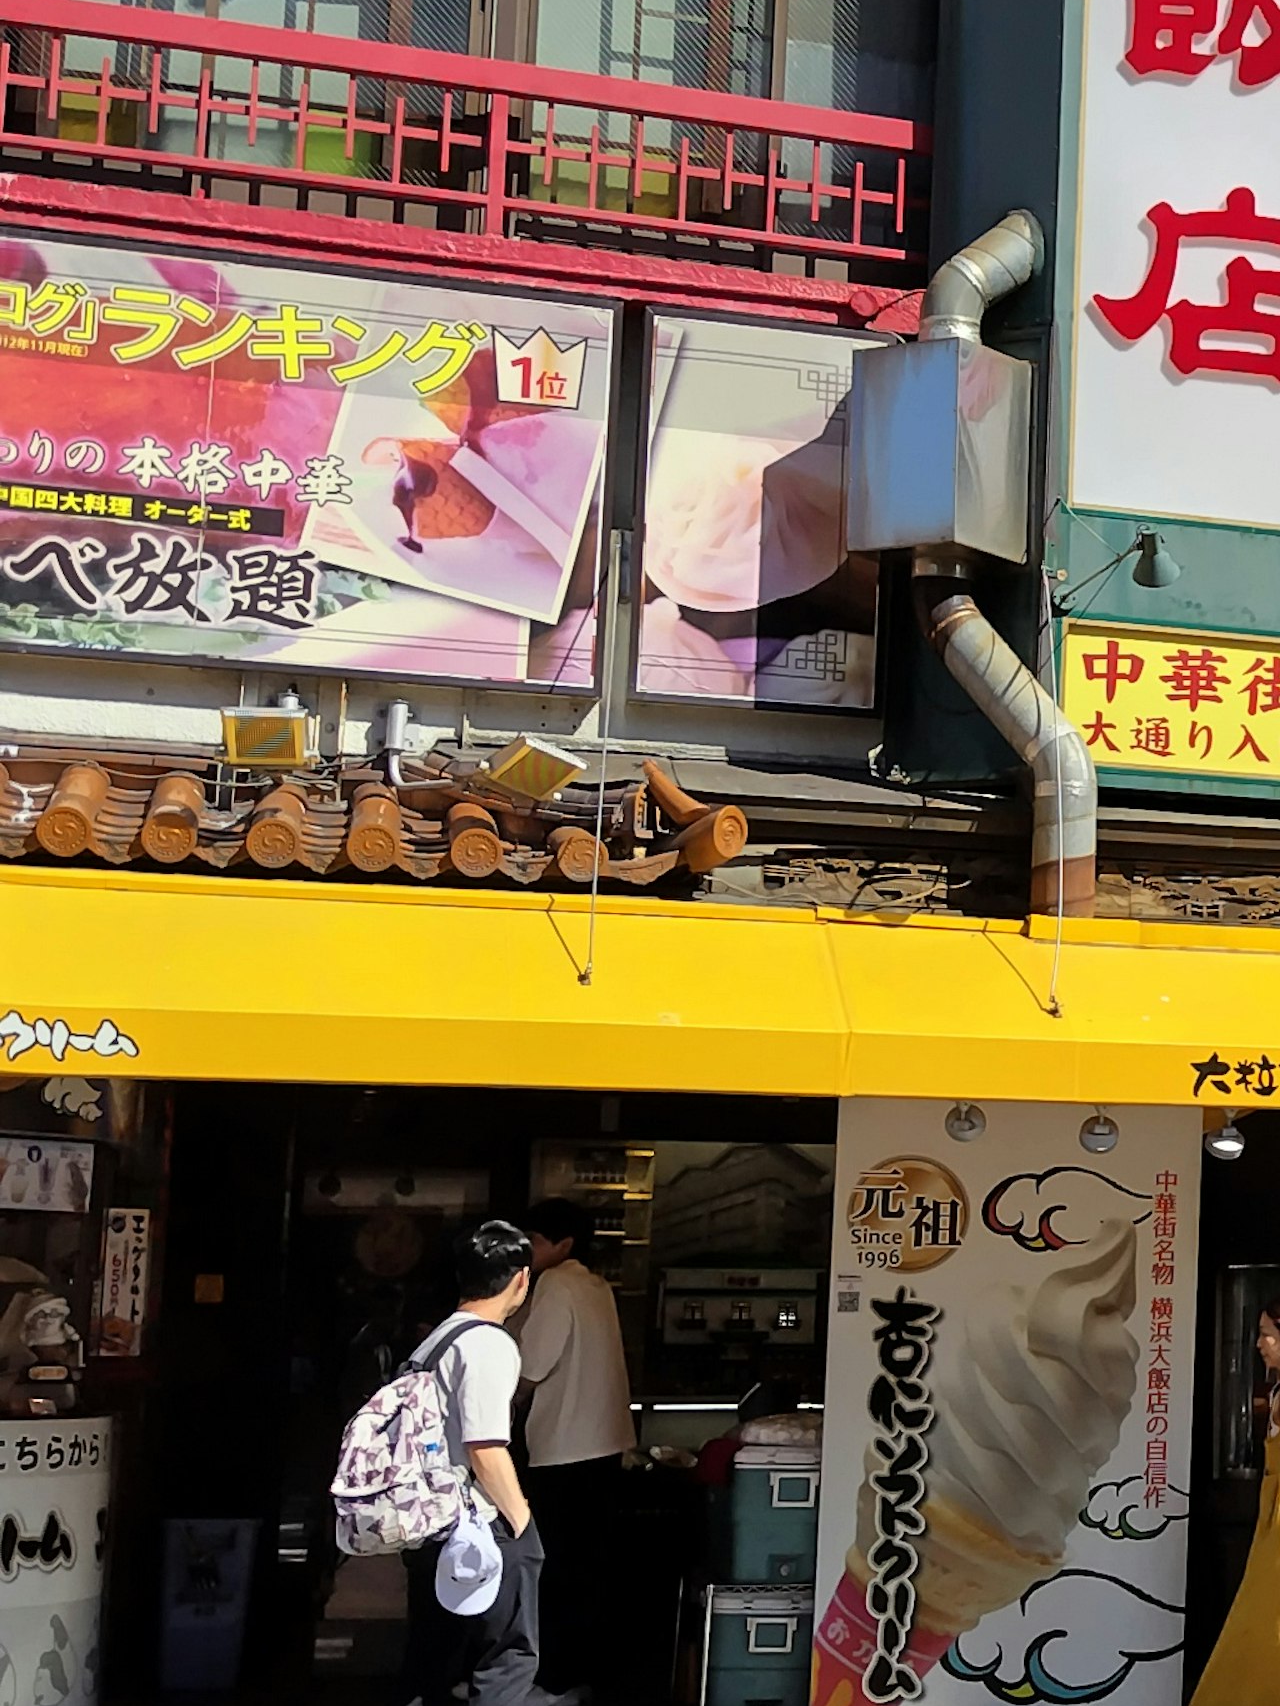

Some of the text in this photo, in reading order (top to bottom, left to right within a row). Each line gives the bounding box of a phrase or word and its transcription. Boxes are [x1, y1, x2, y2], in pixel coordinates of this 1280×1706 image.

[0, 334, 90, 358] 12年11月現在)
[511, 356, 568, 400] 1位
[851, 1167, 962, 1247] 元祖
[850, 1228, 903, 1245] Since
[857, 1249, 901, 1269] 1996
[1143, 1169, 1179, 1510] 中華街名物 横浜大飯店の自信作
[865, 1286, 941, 1703] 杏仁ソフトクリーム
